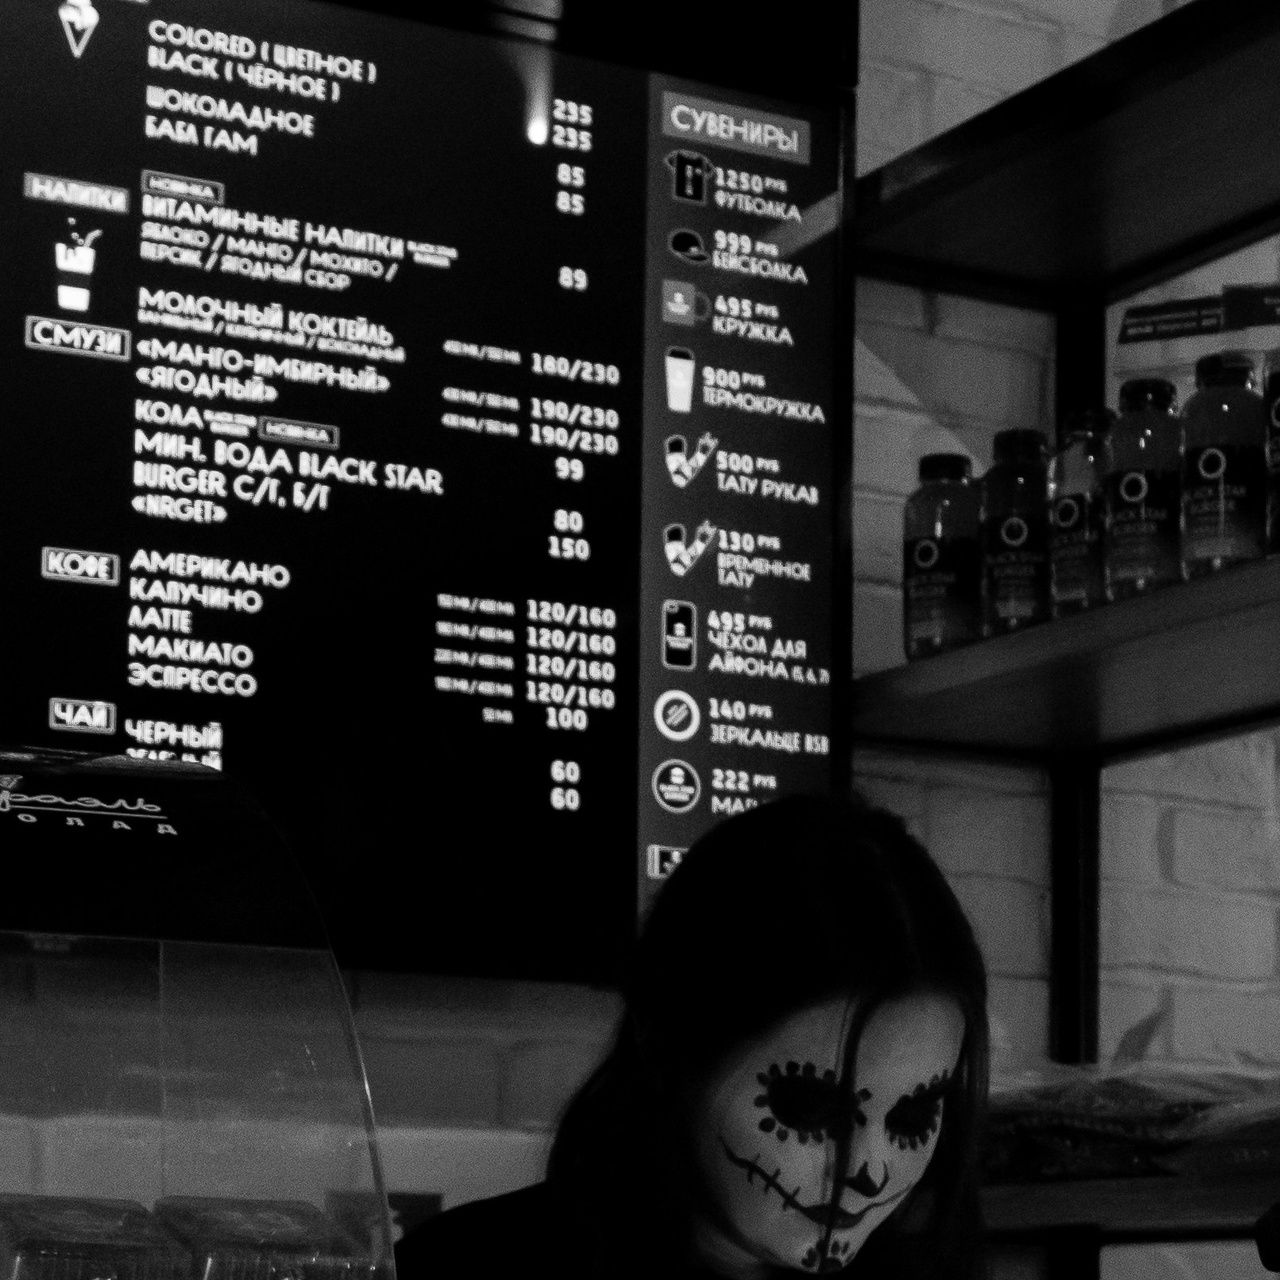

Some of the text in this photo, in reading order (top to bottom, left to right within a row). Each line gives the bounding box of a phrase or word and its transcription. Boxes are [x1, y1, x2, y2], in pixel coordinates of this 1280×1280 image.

[148, 20, 255, 60] COLORED
[148, 45, 218, 79] BLACK
[146, 85, 315, 138] ШОКОЛАДНОЕ
[203, 128, 258, 156] ГАМ
[670, 104, 799, 153] СУВЕНИРЫ
[142, 194, 301, 242] ВИТАМИННЫЕ
[304, 222, 405, 259] НАПИТКИ
[138, 286, 394, 348] МОЛОЧНЫЙ КОКТЕЙЛЬ
[713, 316, 795, 347] КРУЖКА
[33, 320, 123, 354] СМУЗИ
[135, 399, 203, 429] КОЛА
[703, 385, 826, 424] ТЕРМОКРУЖКА
[134, 428, 445, 496] МИН. ВОДА BLACK STAR
[133, 460, 228, 497] BURGER
[548, 535, 591, 562] 150
[48, 550, 110, 581] КОФЕ
[129, 548, 291, 590] АМЕРИКАНО
[129, 576, 263, 615] КАПУЧИНО
[128, 604, 193, 634] ЛАТТЕ
[526, 598, 617, 630] 120/160
[128, 633, 254, 669] МАКИАТО
[526, 625, 617, 657] 120/160
[127, 661, 258, 698] ЭСПРЕССО
[526, 652, 616, 683] 120/160
[708, 651, 790, 679] АЙФОНА
[526, 679, 616, 710] 120/160
[53, 701, 109, 728] ЧАЙ
[545, 706, 588, 732] 100
[125, 718, 224, 750] ЧЕРНЫЙ
[550, 758, 581, 784] 60
[712, 768, 750, 792] 222
[550, 786, 581, 811] 60
